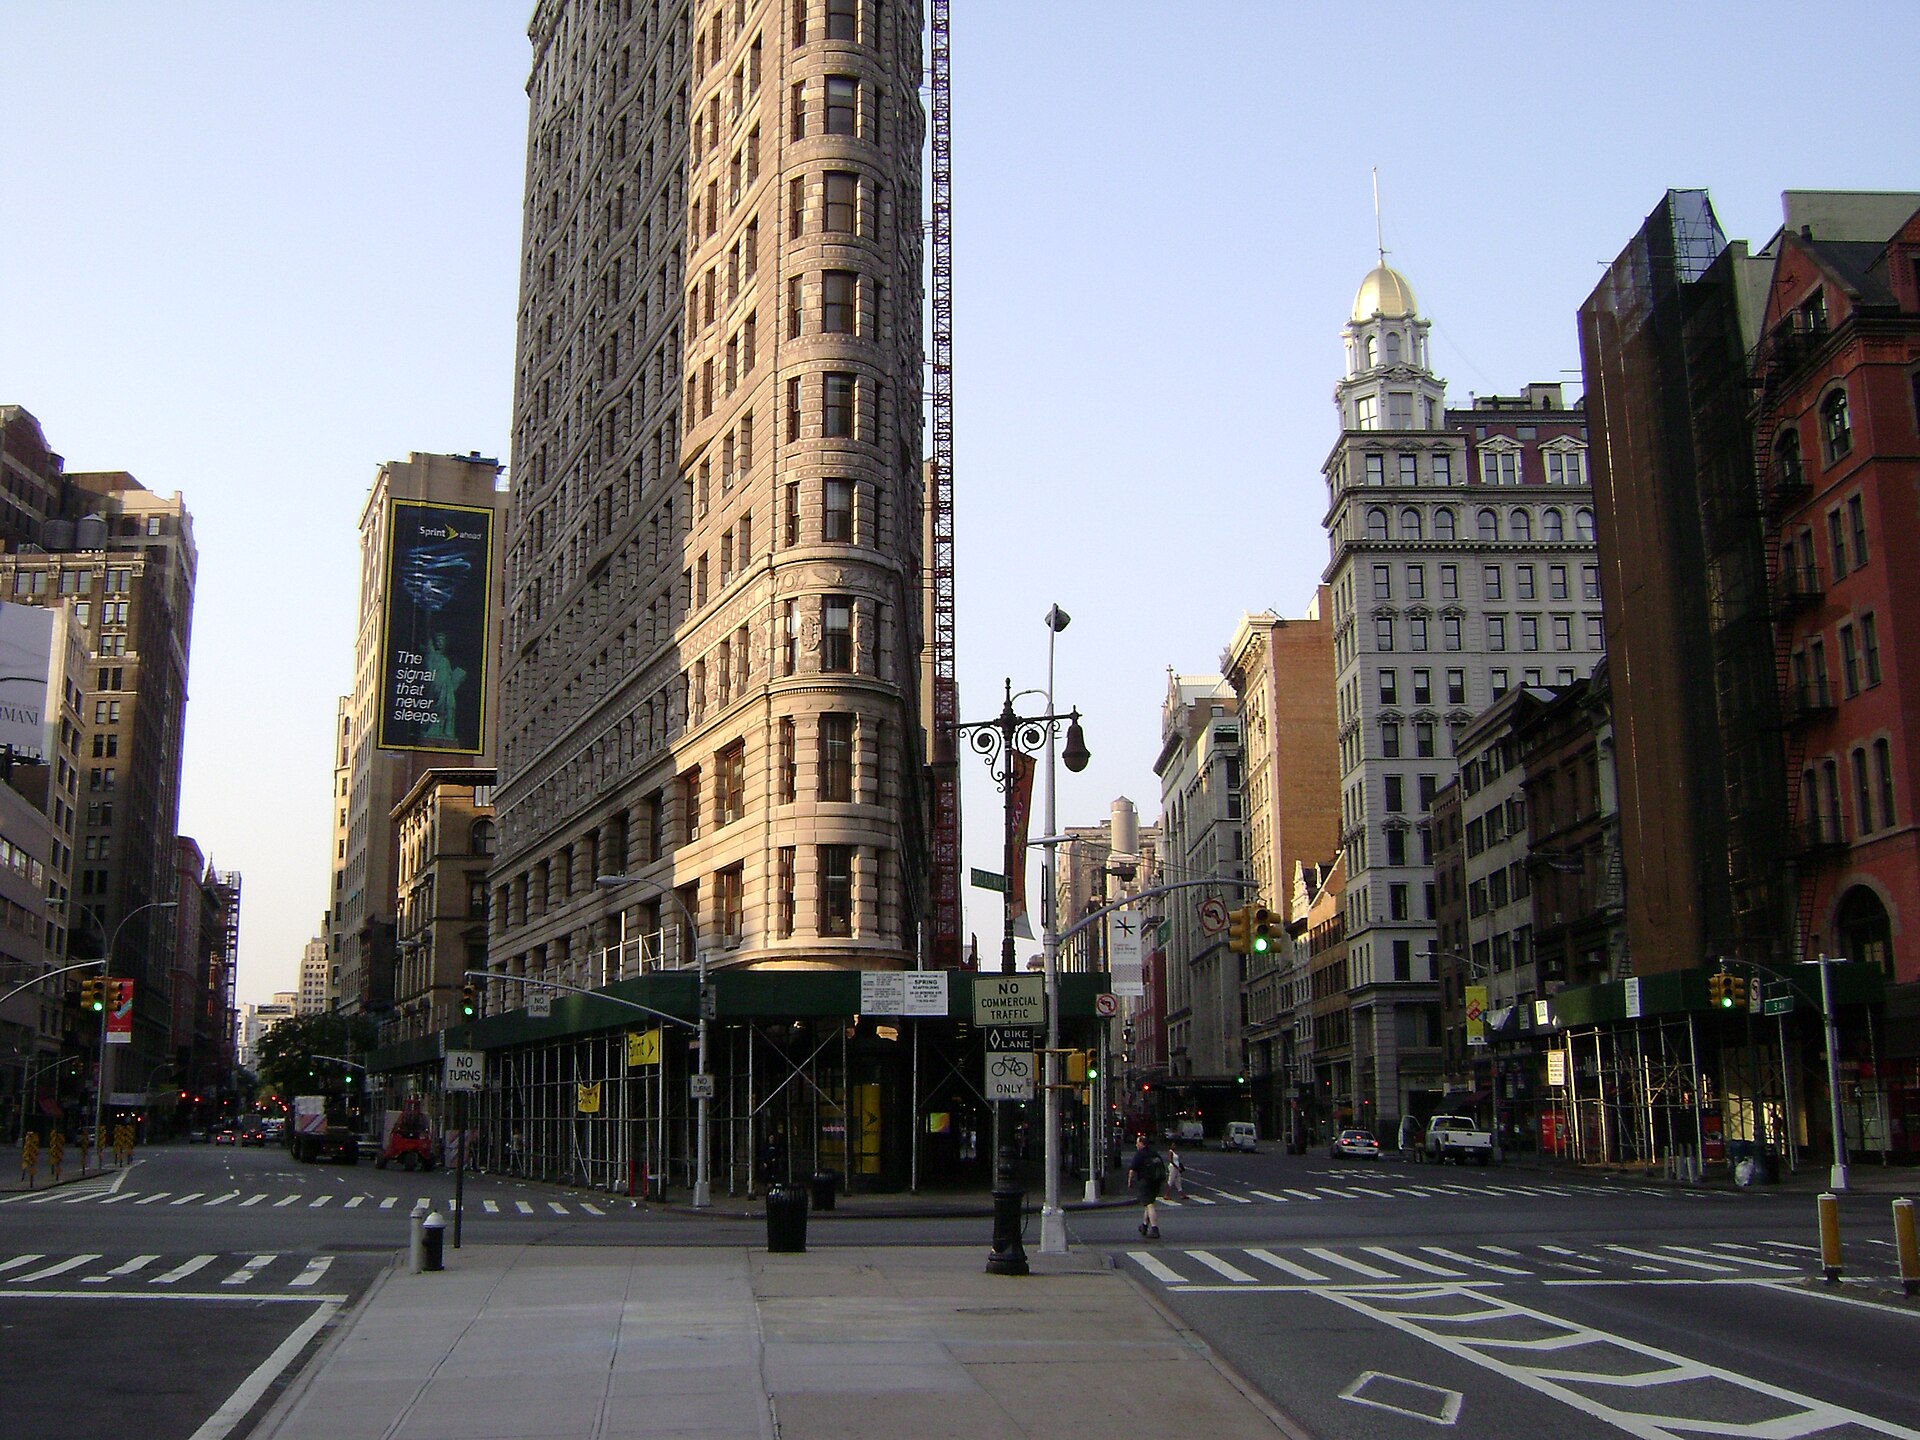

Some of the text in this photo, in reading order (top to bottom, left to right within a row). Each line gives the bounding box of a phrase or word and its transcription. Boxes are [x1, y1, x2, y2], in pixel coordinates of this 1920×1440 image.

[419, 525, 446, 538] Sprint
[398, 650, 423, 665] The
[396, 667, 437, 684] signal
[396, 682, 425, 696] that
[395, 697, 434, 709] never
[393, 708, 441, 724] sleeps.
[998, 982, 1019, 995] NO
[534, 996, 544, 1005] NO
[981, 996, 1038, 1008] COMMERCIAL
[990, 1008, 1029, 1020] TRAFFIC
[1004, 1030, 1029, 1038] BIKE
[1001, 1040, 1031, 1048] LANE
[456, 1056, 473, 1068] NO
[449, 1069, 481, 1082] TURNS
[697, 1077, 708, 1085] NO
[996, 1083, 1023, 1094] ONLY
